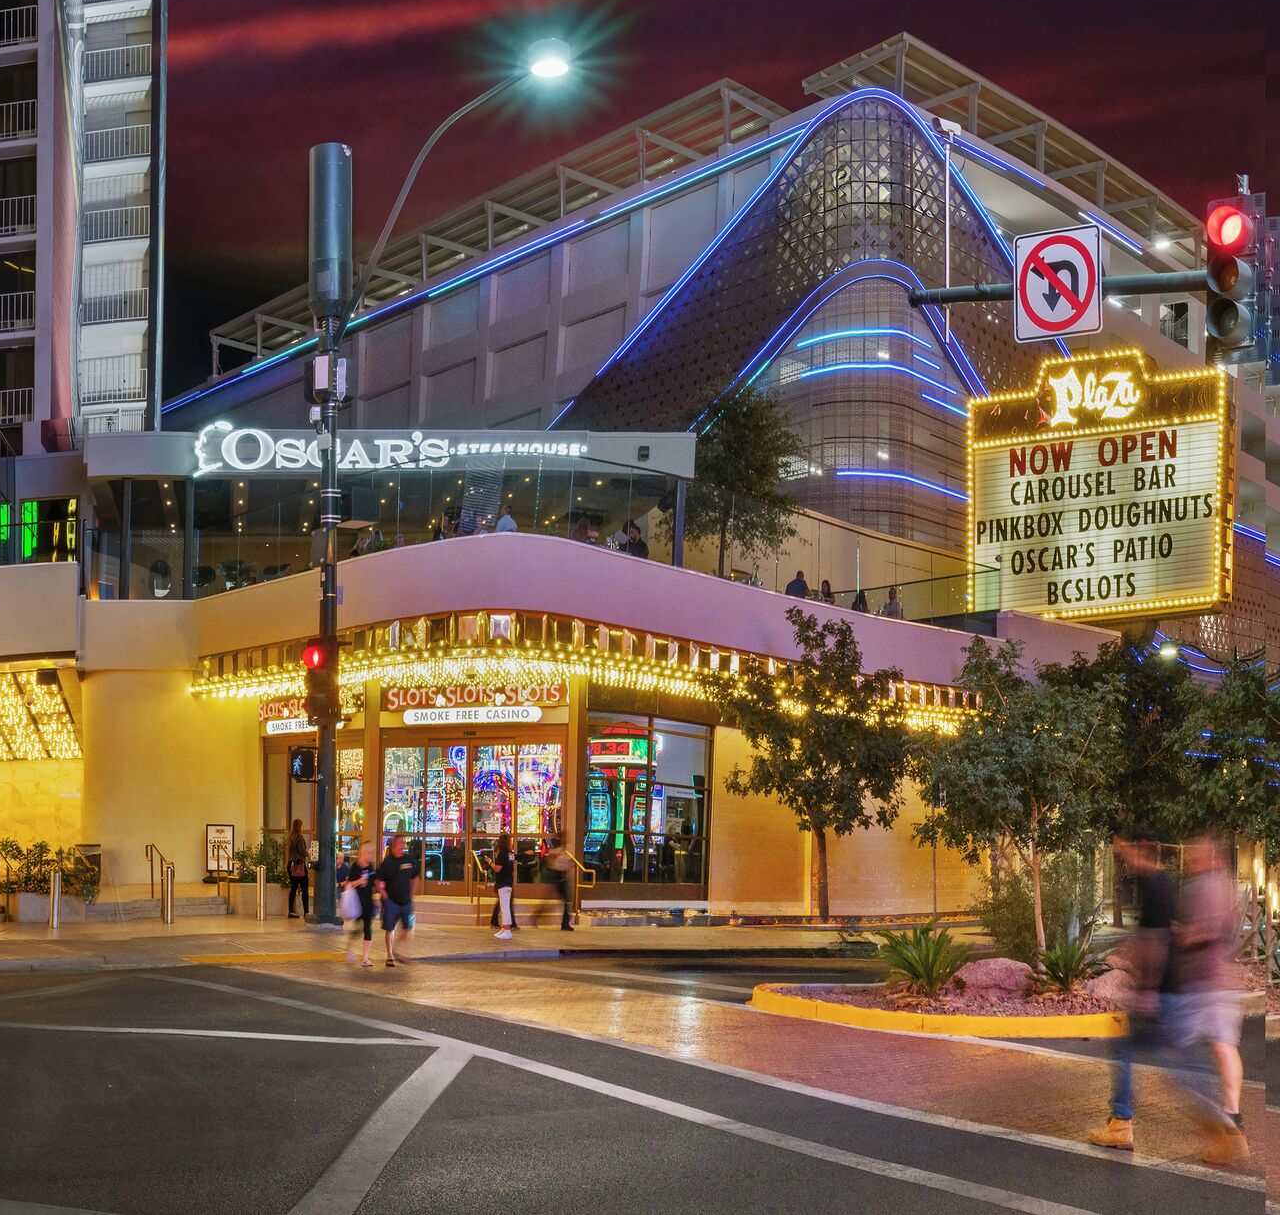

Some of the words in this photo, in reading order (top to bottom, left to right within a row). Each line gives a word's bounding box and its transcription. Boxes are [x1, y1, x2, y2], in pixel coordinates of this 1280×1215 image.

[1048, 366, 1141, 427] Plaza
[457, 443, 581, 456] STEAKHOUSE
[1009, 440, 1074, 478] NOW
[1098, 429, 1178, 467] OPEN
[1010, 472, 1116, 506] CAROUSEL
[1134, 463, 1177, 492] BAR
[977, 511, 1064, 545] PINKBOX
[1079, 493, 1213, 533] DOUGHNUTS
[1011, 542, 1095, 576] OSCAR'S
[1113, 533, 1173, 564] PATIO
[1047, 572, 1137, 606] BCSLOTS
[258, 699, 283, 722] SLOTS
[387, 689, 437, 709] SLOTS
[446, 685, 495, 707] SLOTS
[505, 683, 560, 706] SLOTS
[272, 722, 292, 732] SMOKE
[295, 719, 309, 727] FREE
[413, 711, 450, 723] SMOKE
[456, 709, 479, 720] FREE
[486, 707, 530, 720] CASINO
